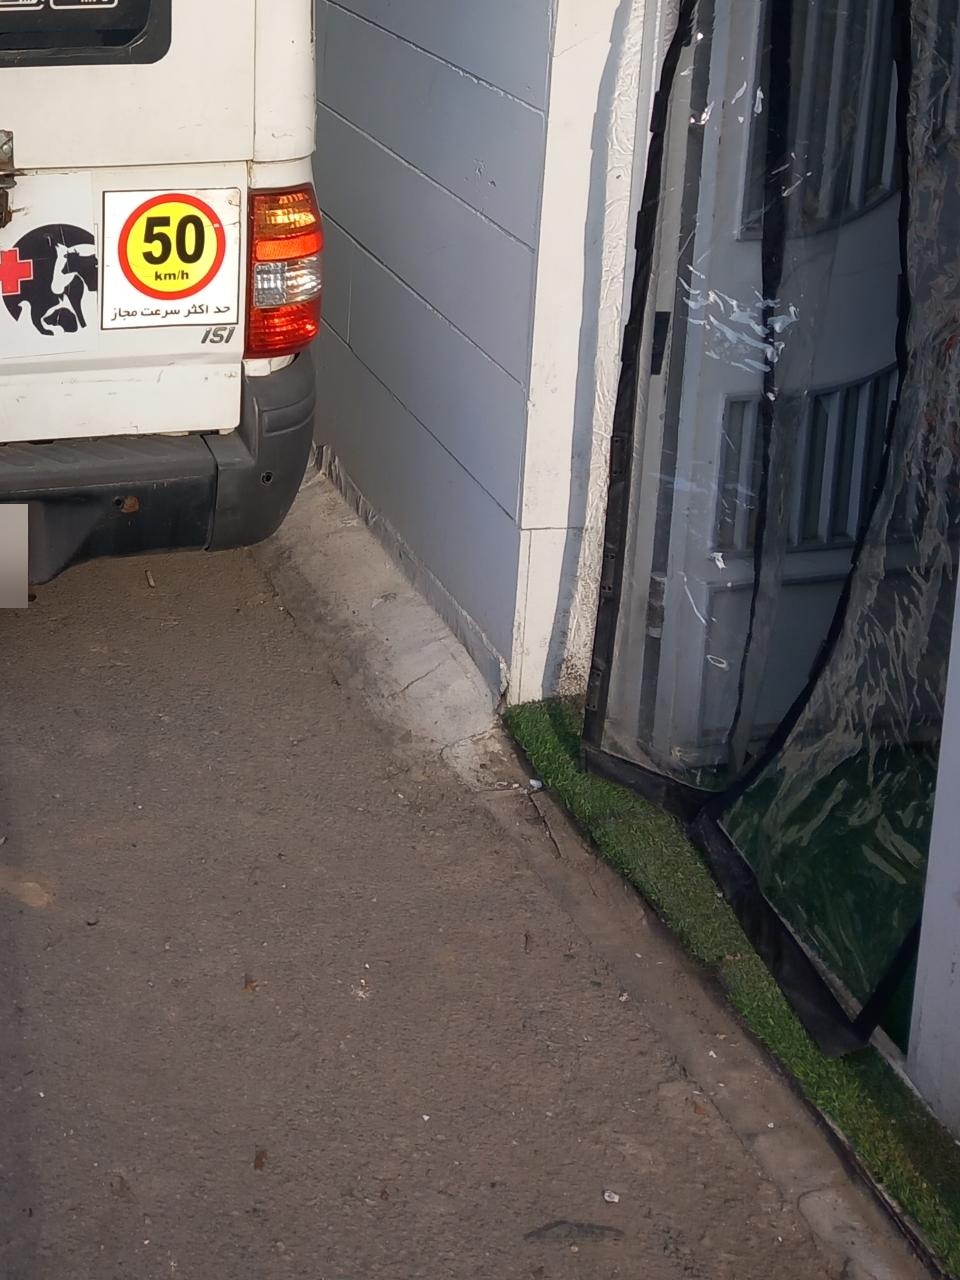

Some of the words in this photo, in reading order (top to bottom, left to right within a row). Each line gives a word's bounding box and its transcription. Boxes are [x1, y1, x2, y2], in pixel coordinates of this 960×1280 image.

[141, 214, 205, 265] 50
[154, 270, 190, 281] km/h
[111, 307, 137, 321] مجاز
[141, 306, 181, 318] سرعت
[184, 304, 209, 318] اکثر
[213, 305, 231, 315] حد
